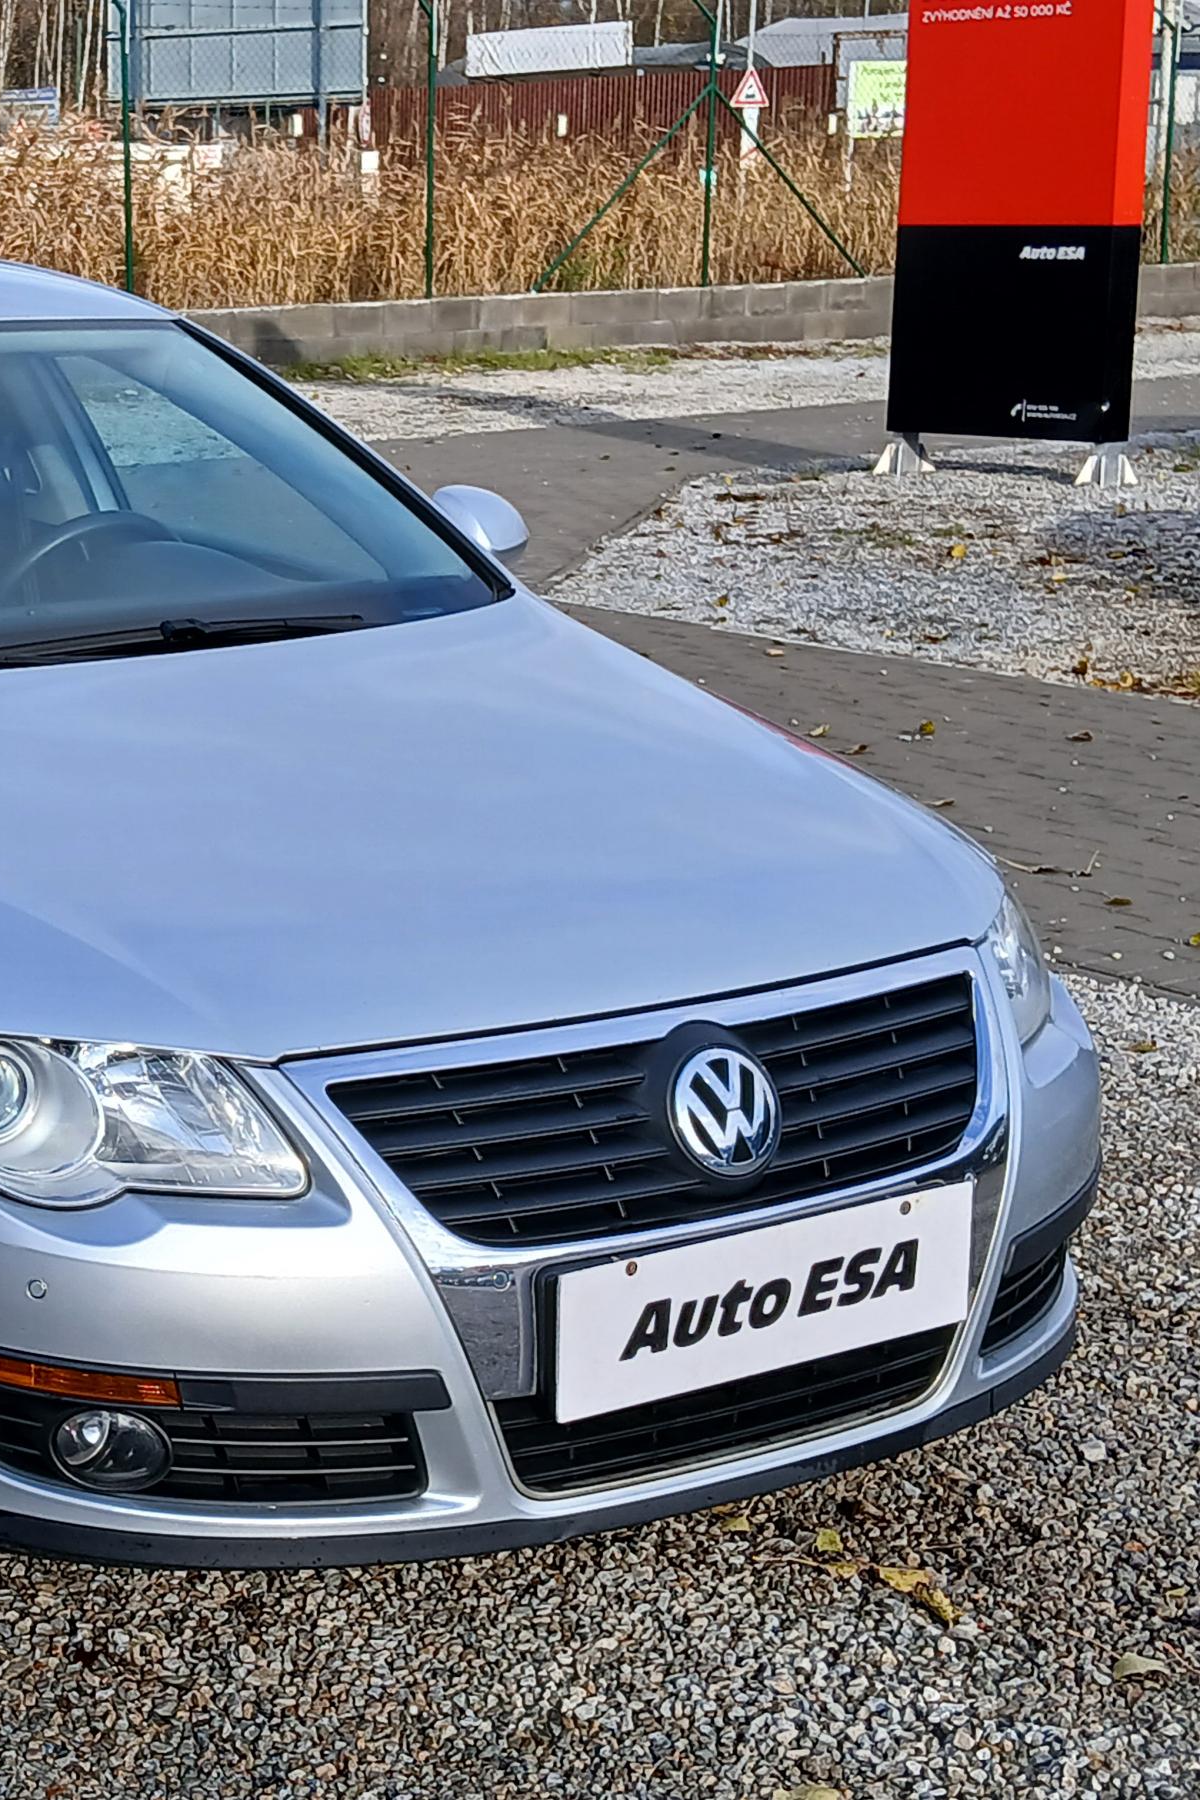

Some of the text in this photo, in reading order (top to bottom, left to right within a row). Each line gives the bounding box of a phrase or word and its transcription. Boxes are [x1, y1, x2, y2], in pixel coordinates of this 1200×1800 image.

[995, 4, 1011, 18] AŽ
[1013, 6, 1028, 18] 50
[1030, 4, 1053, 17] 000
[1056, 1, 1072, 15] KČ
[1019, 245, 1086, 260] Auto ESA
[619, 1238, 919, 1361] Auto ESA
